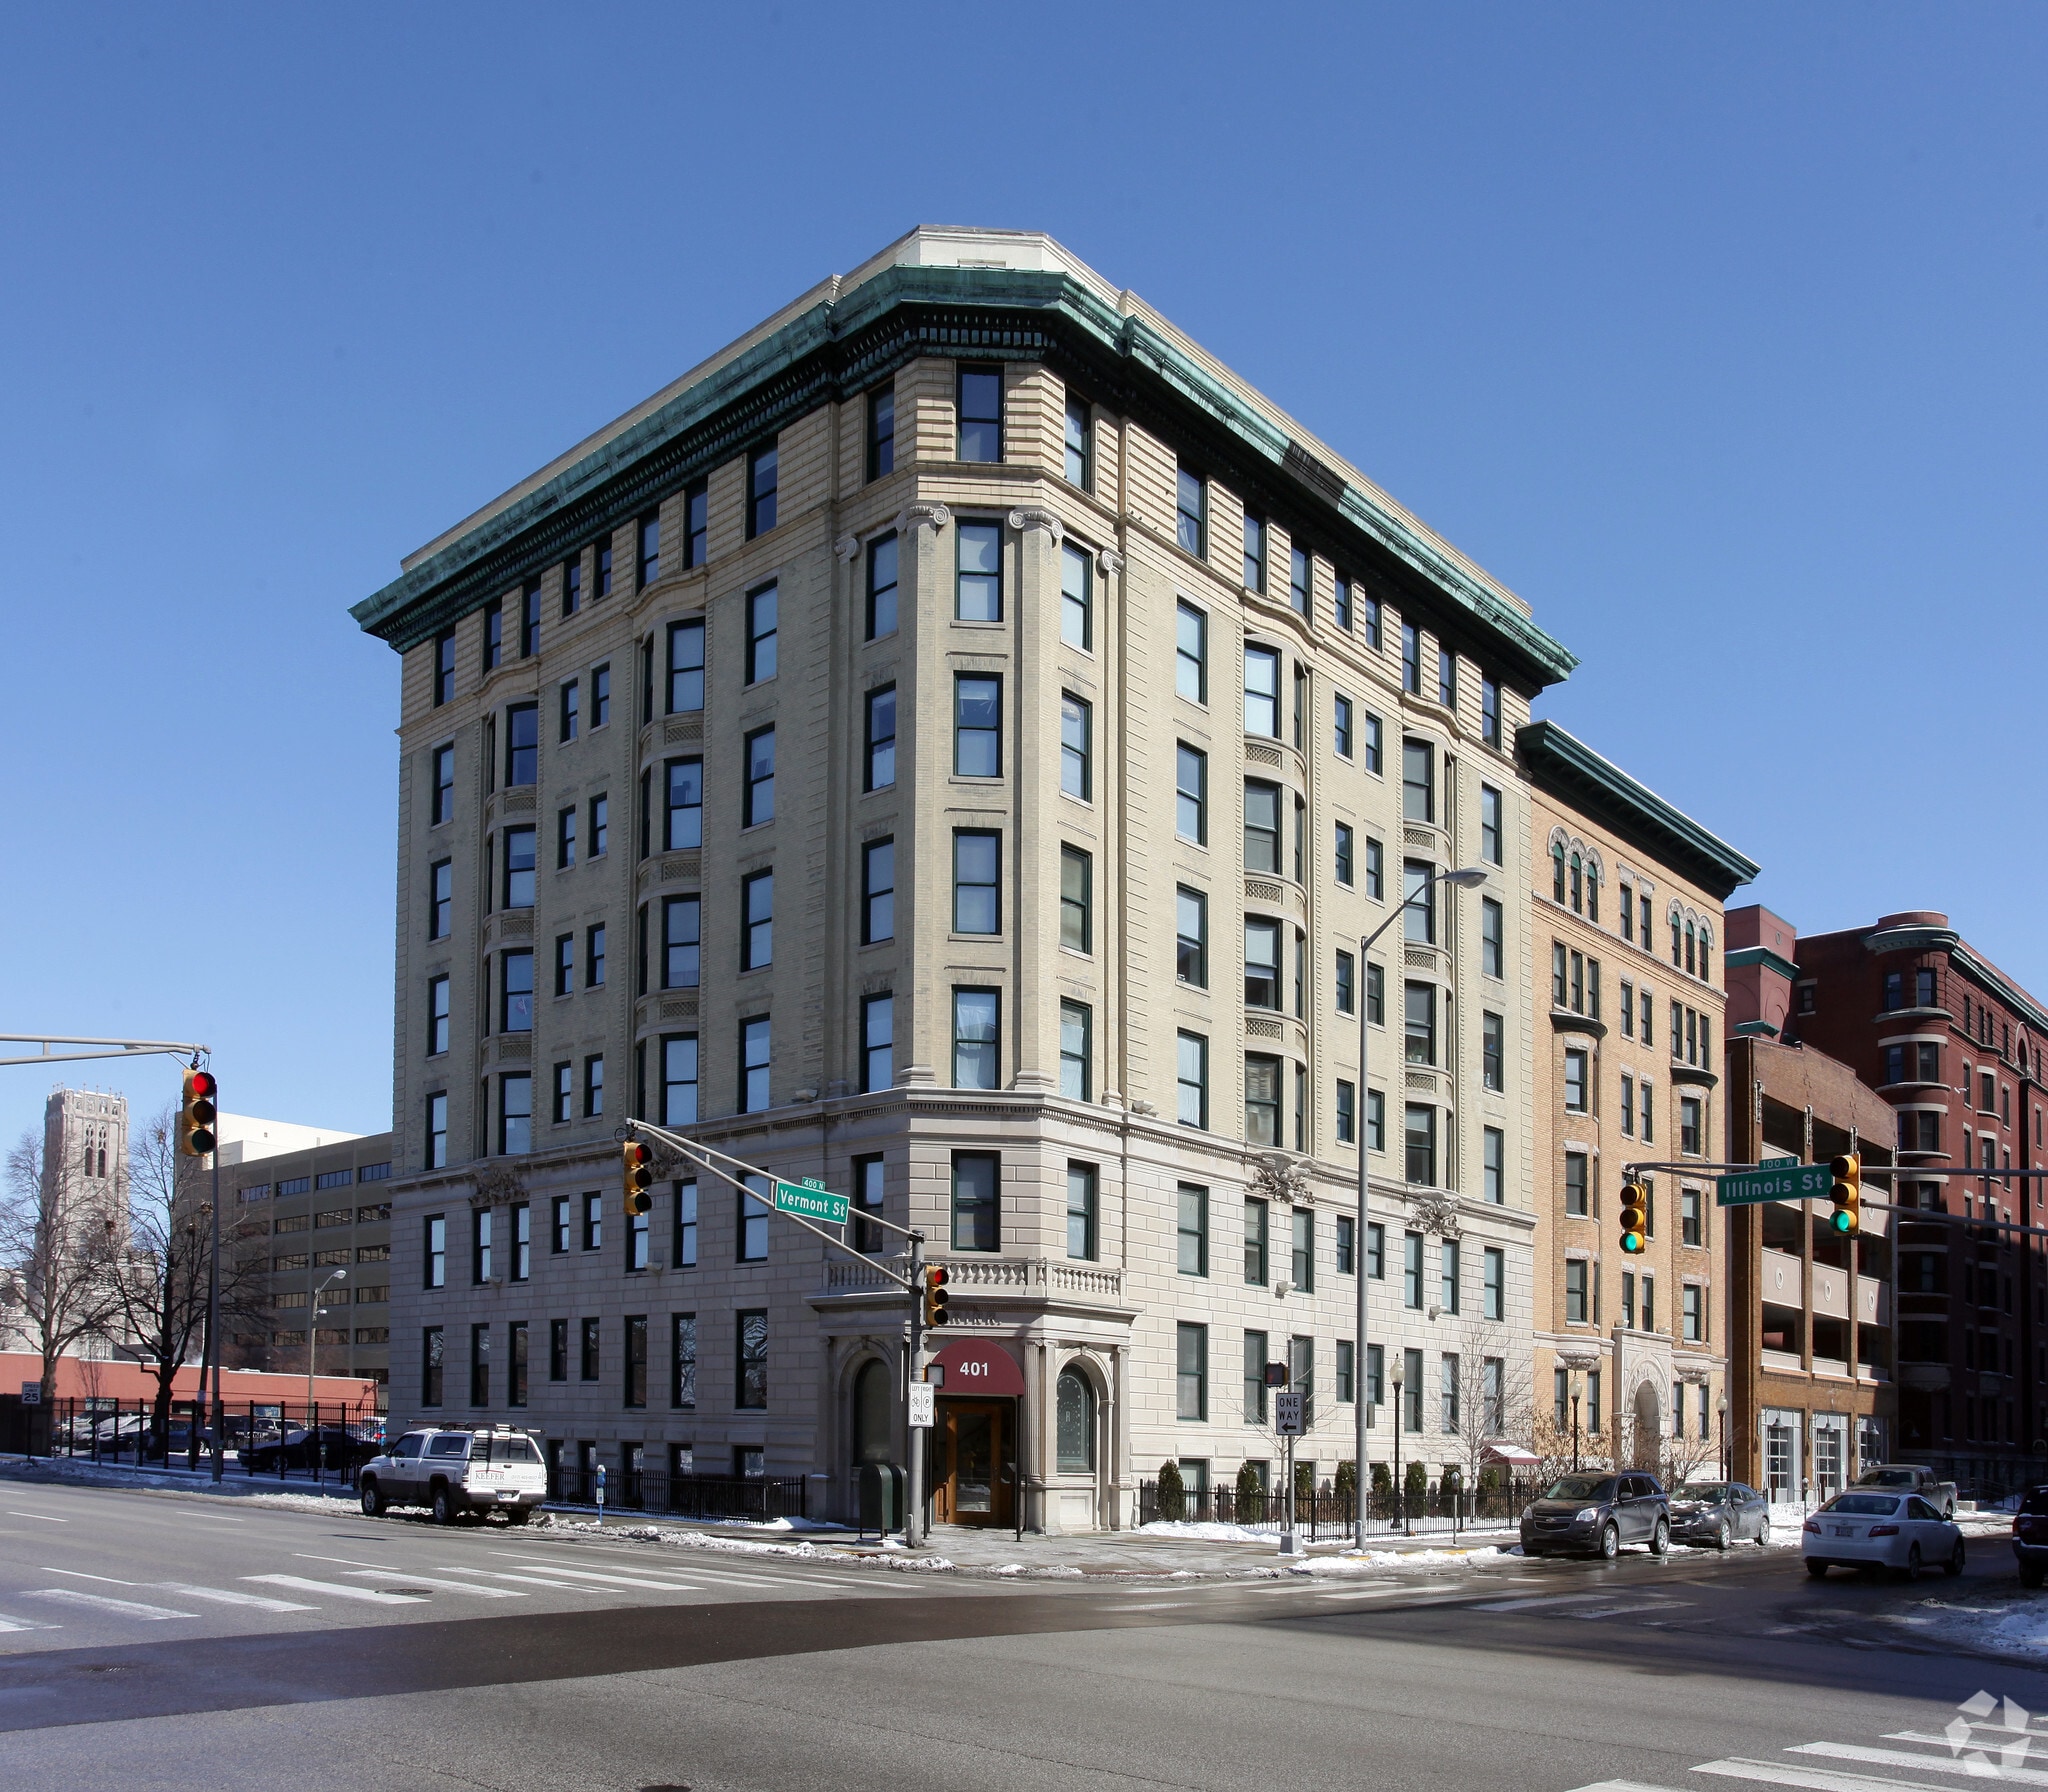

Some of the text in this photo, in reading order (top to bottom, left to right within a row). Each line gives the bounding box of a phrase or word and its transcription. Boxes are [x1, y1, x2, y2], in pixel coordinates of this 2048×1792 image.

[1762, 1157, 1794, 1169] 100 W
[803, 1178, 824, 1190] 400 N
[1725, 1173, 1823, 1198] Illinois St
[780, 1189, 846, 1217] Vermont St
[959, 1361, 989, 1377] 401
[24, 1393, 39, 1402] 25
[1279, 1397, 1298, 1407] ONE
[913, 1413, 929, 1423] ONLY
[1279, 1411, 1299, 1420] WAY
[475, 1472, 505, 1480] KEEFER
